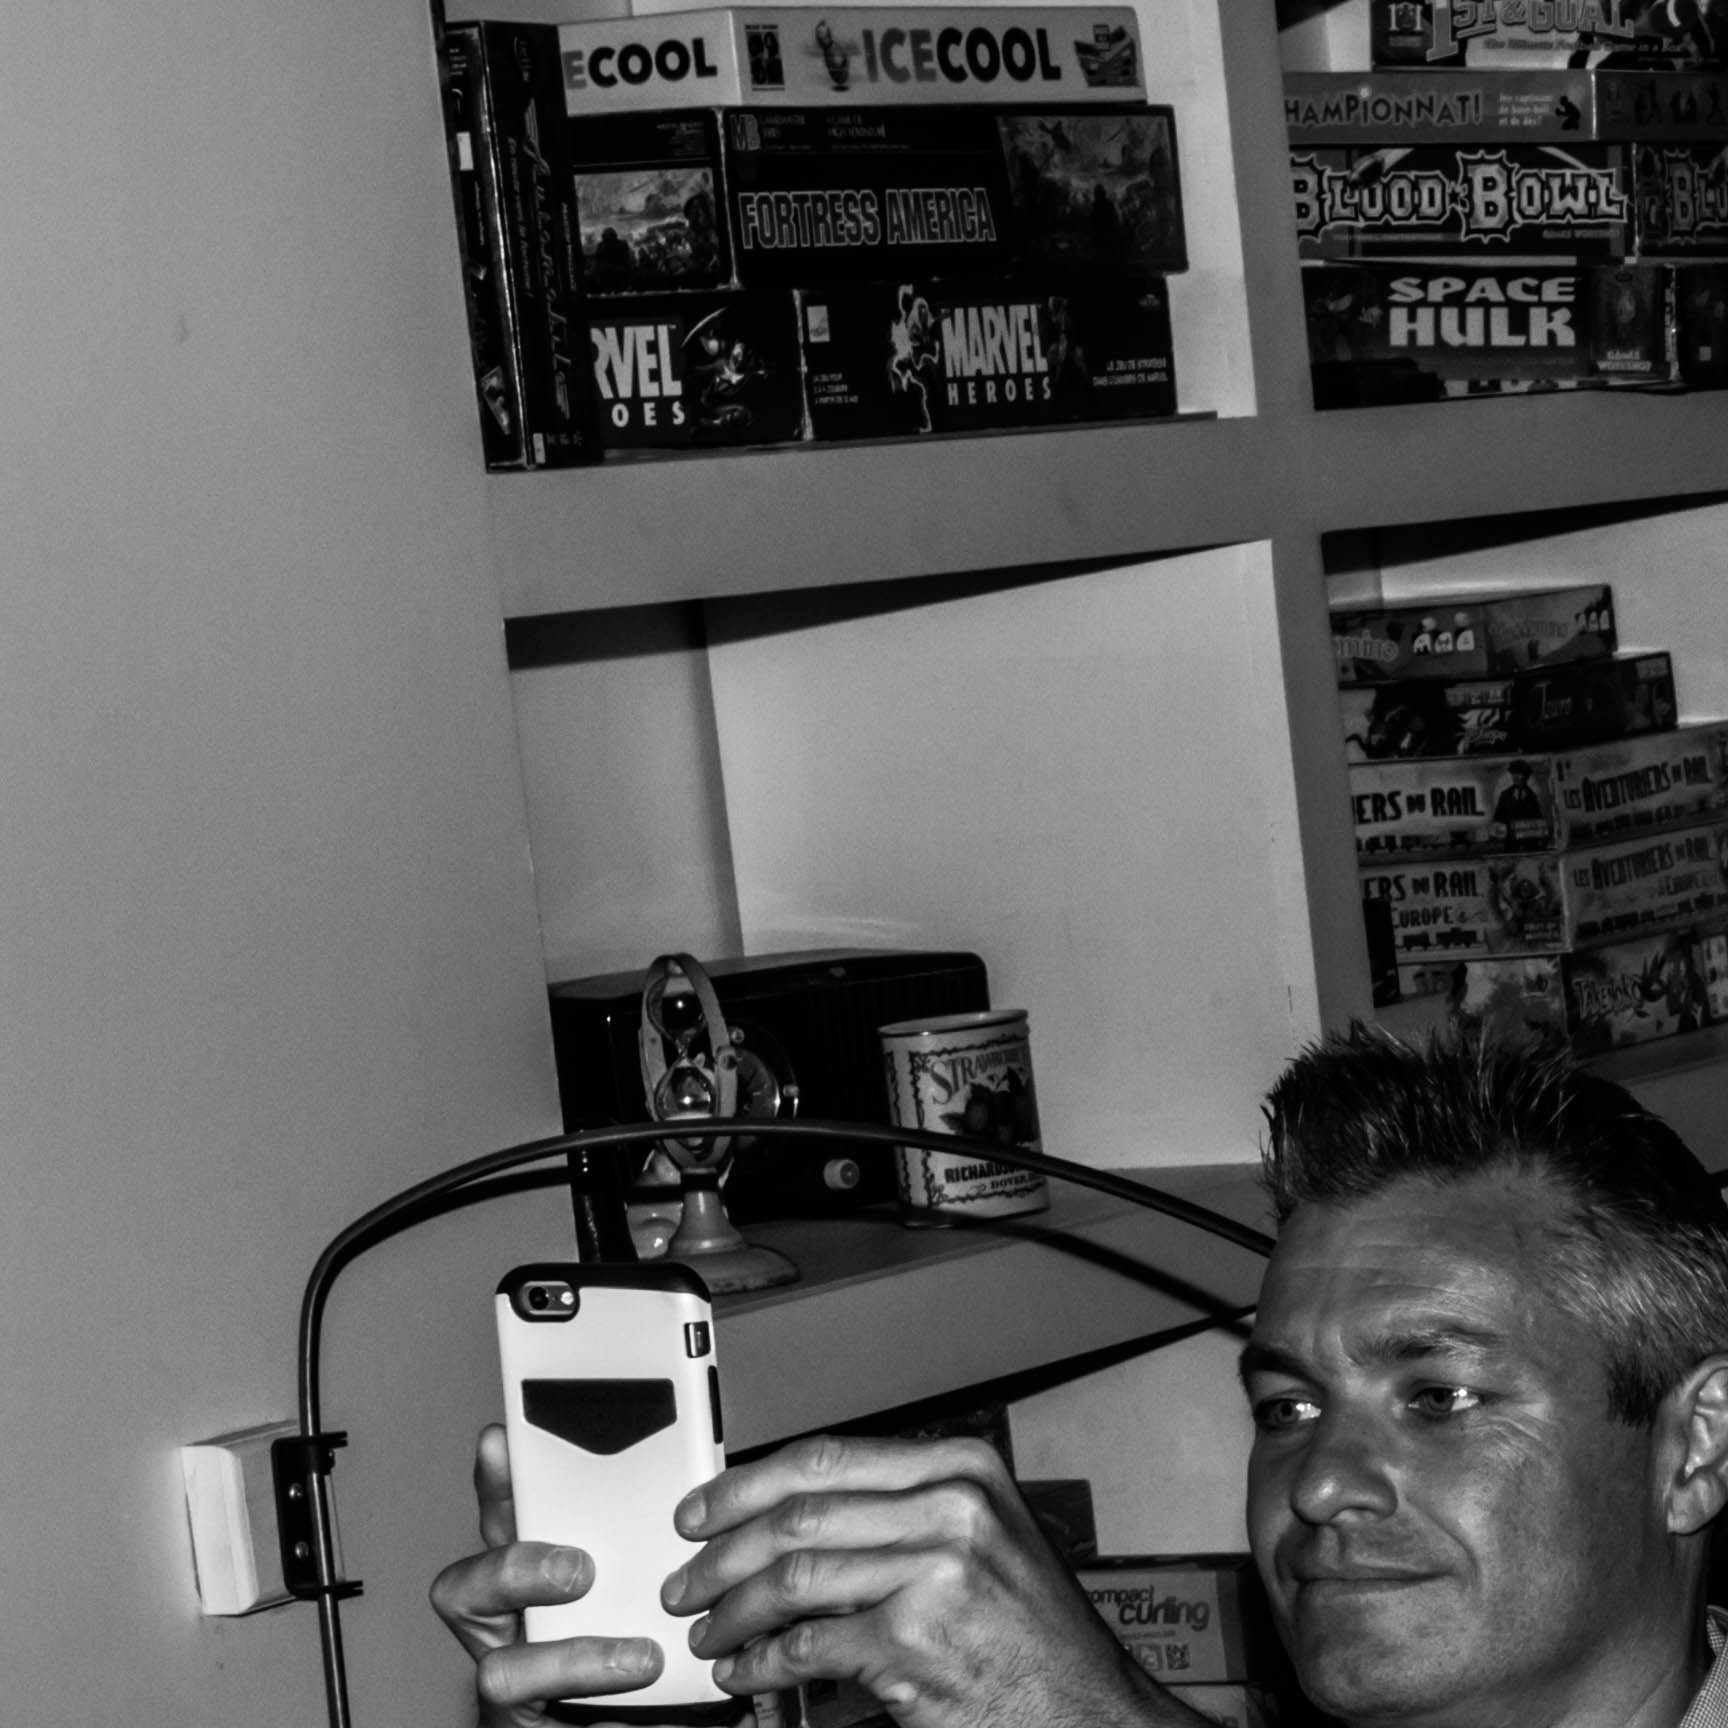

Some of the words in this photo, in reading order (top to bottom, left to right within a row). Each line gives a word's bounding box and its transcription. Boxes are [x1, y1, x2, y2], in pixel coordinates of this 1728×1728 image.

[861, 27, 1063, 84] ICECOOL
[1285, 87, 1483, 128] HAMPIONNAT!
[1290, 153, 1451, 243] BLOOD
[1455, 150, 1629, 242] BOWL
[737, 190, 881, 250] FORTRESS
[885, 187, 998, 245] AMERICA
[1387, 276, 1577, 303] SPACE
[941, 303, 1049, 378] MARVEL
[1388, 306, 1577, 347] HULK
[946, 376, 1053, 408] HEROES
[1430, 785, 1485, 817] RAIL
[1582, 761, 1672, 813] AVENTURIERS
[1433, 871, 1480, 898] RAIL
[943, 1161, 1016, 1184] RICHARD
[1119, 1595, 1211, 1633] curling
